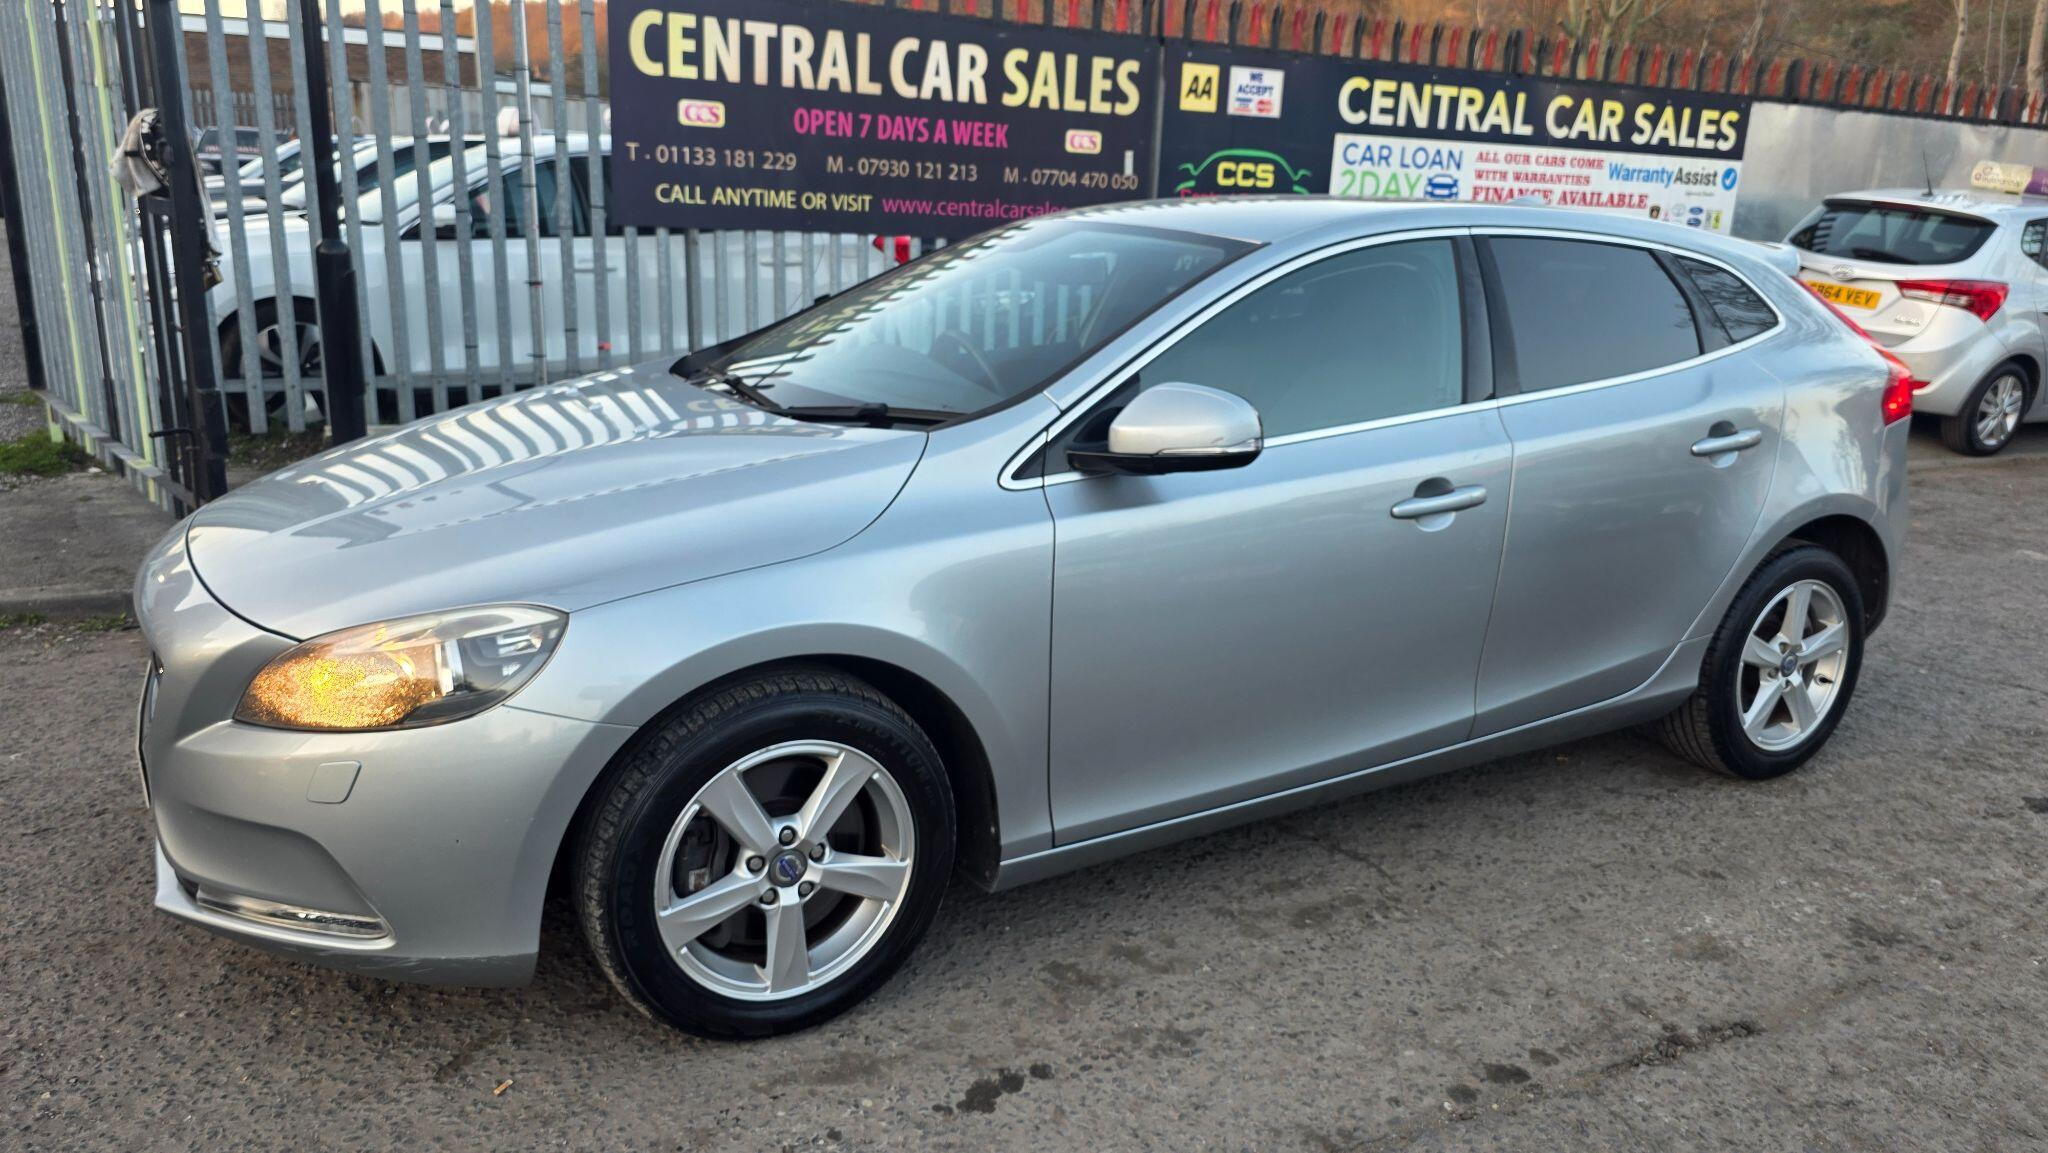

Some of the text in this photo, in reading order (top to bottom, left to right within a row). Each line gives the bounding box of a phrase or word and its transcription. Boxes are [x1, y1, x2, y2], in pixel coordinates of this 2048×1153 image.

[629, 9, 1141, 116] CENTRAL CAR SALES
[1185, 75, 1213, 100] AA
[1250, 71, 1263, 82] WE
[1237, 84, 1274, 97] ACCEPT
[1337, 76, 1740, 152] CENTRAL CAR SALES
[793, 108, 1009, 148] OPEN 7 DAYS A WEEK
[625, 141, 640, 161] T
[655, 144, 717, 166] 01133
[724, 149, 755, 168] 181
[762, 152, 797, 171] 229
[827, 155, 844, 174] M
[857, 157, 910, 178] 07930
[915, 162, 942, 180] 121
[948, 164, 978, 182] 213
[1342, 142, 1464, 172] CAR LOAN
[1475, 151, 1605, 170] ALL OUR CARS COME
[1003, 166, 1019, 184] M
[1031, 169, 1077, 188] 07704
[1080, 172, 1109, 190] 470
[1217, 161, 1275, 188] CCS
[1339, 170, 1422, 199] 2DAY
[1474, 169, 1591, 187] WITH WARRANTIES
[1608, 163, 1719, 188] WarrantyAssist
[655, 183, 873, 213] CALL ANYTIME OR VISIT
[881, 198, 1067, 219] www.centralcarsale
[1556, 190, 1649, 210] AVAILABLE
